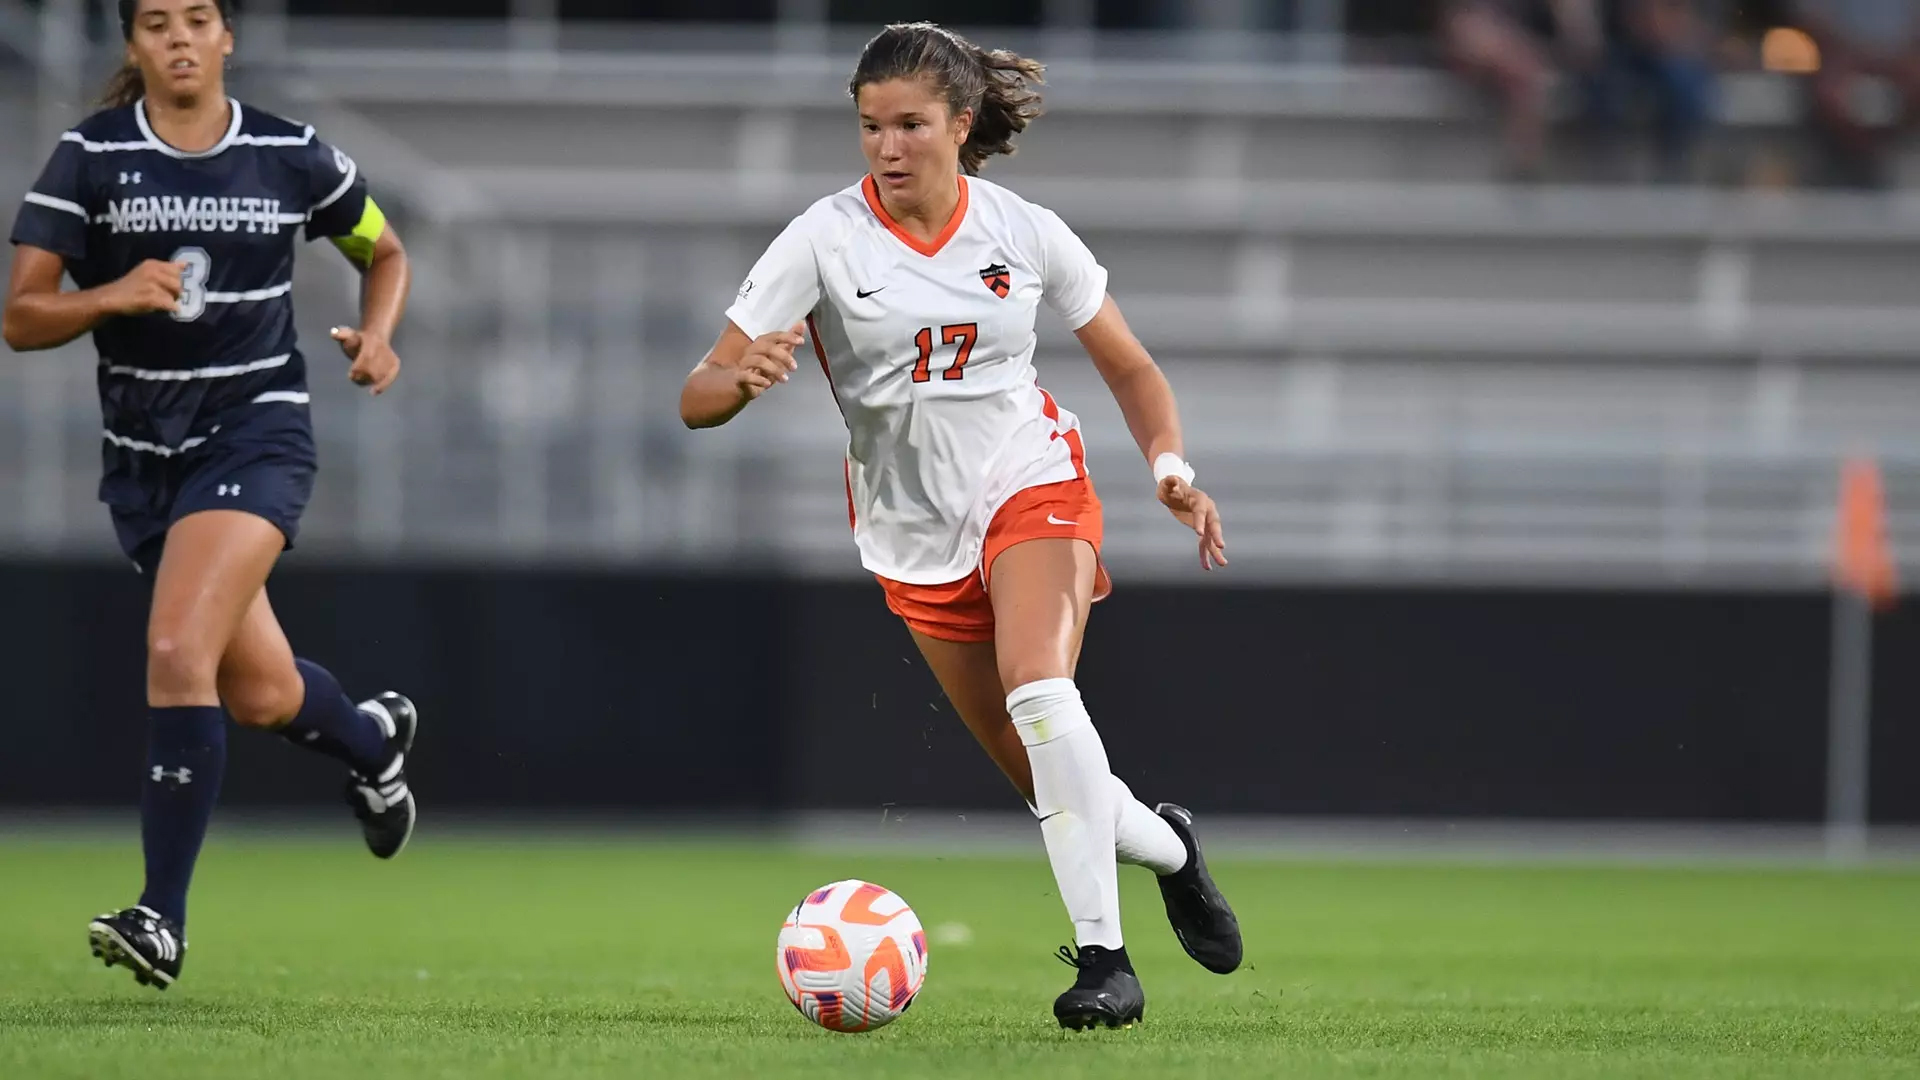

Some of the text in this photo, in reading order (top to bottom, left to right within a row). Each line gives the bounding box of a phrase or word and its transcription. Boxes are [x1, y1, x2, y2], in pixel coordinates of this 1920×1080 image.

[109, 196, 280, 234] MONMOUTH
[169, 246, 211, 322] 3
[911, 322, 978, 383] 17
